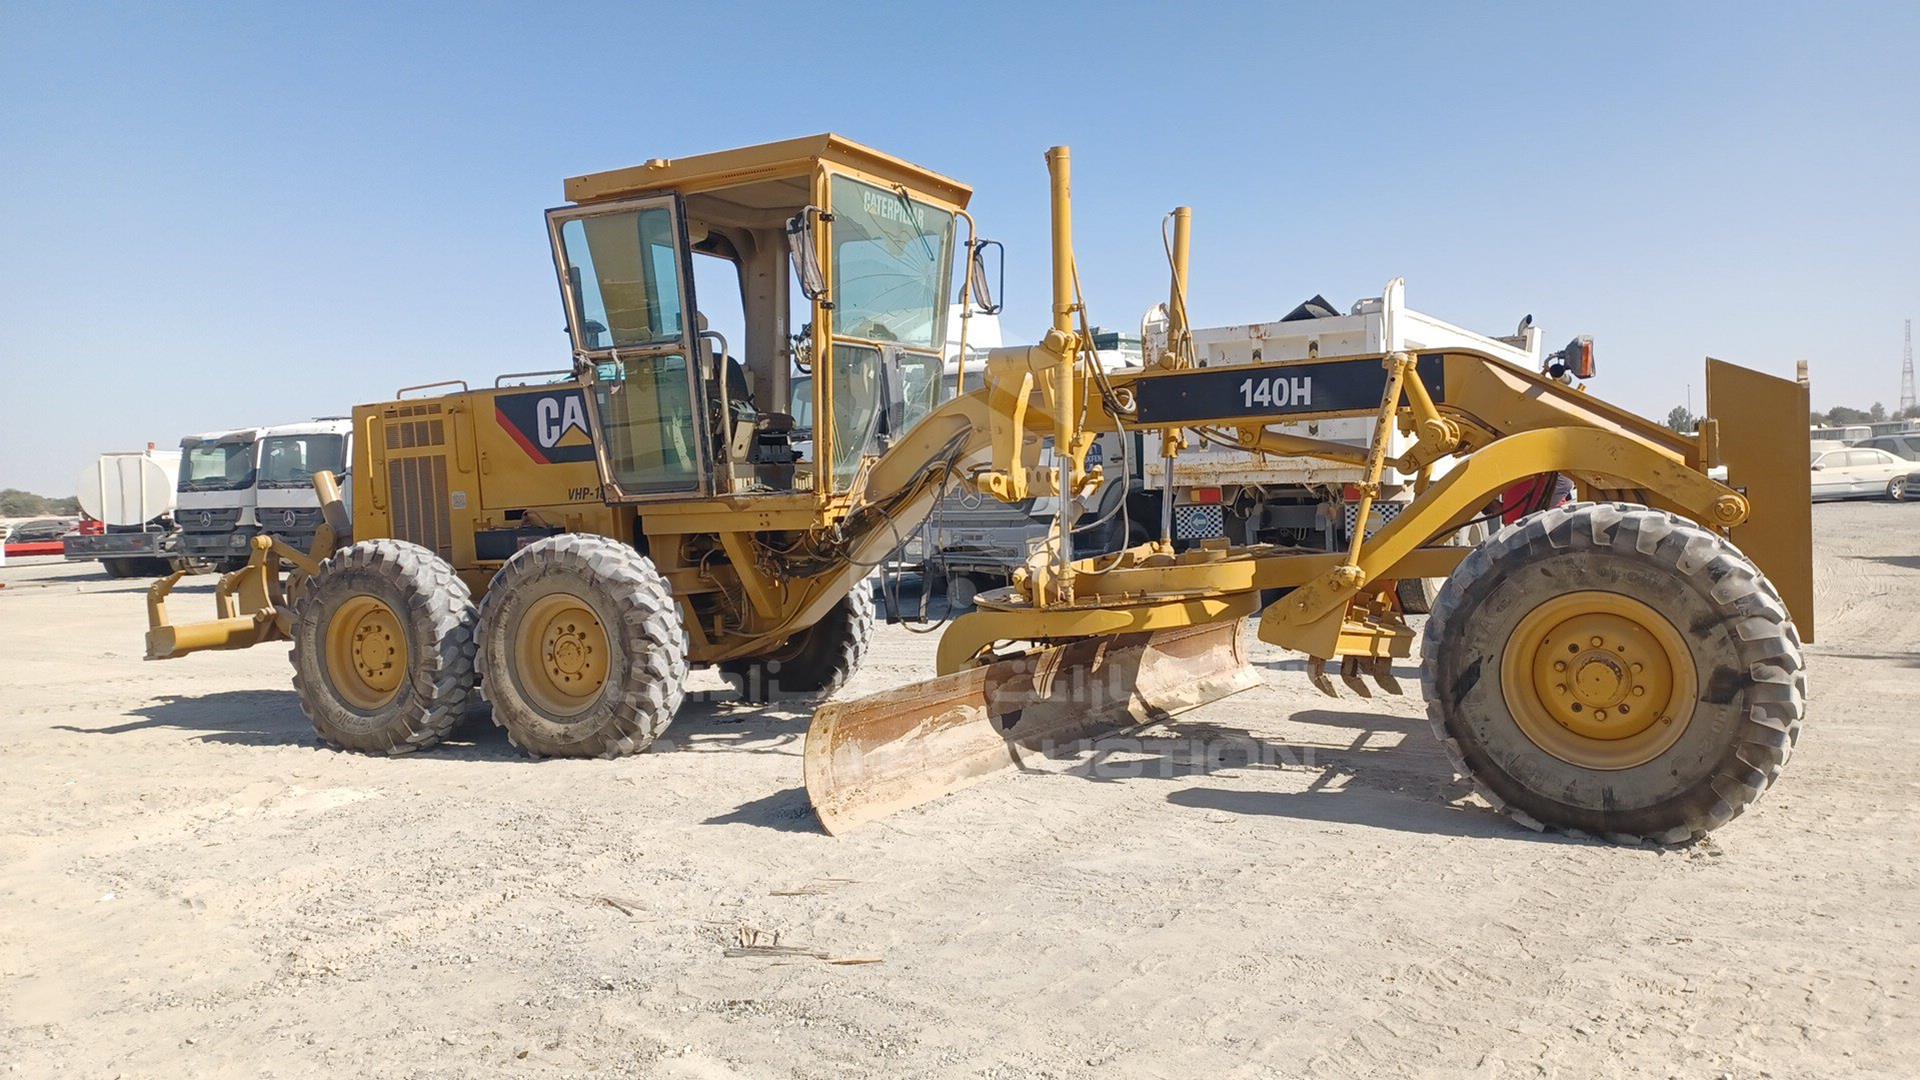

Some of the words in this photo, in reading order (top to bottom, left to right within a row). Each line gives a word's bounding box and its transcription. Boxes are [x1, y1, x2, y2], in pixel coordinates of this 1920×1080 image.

[864, 191, 924, 229] CATERPILLAR
[1240, 377, 1312, 407] 140H
[537, 396, 588, 448] CA
